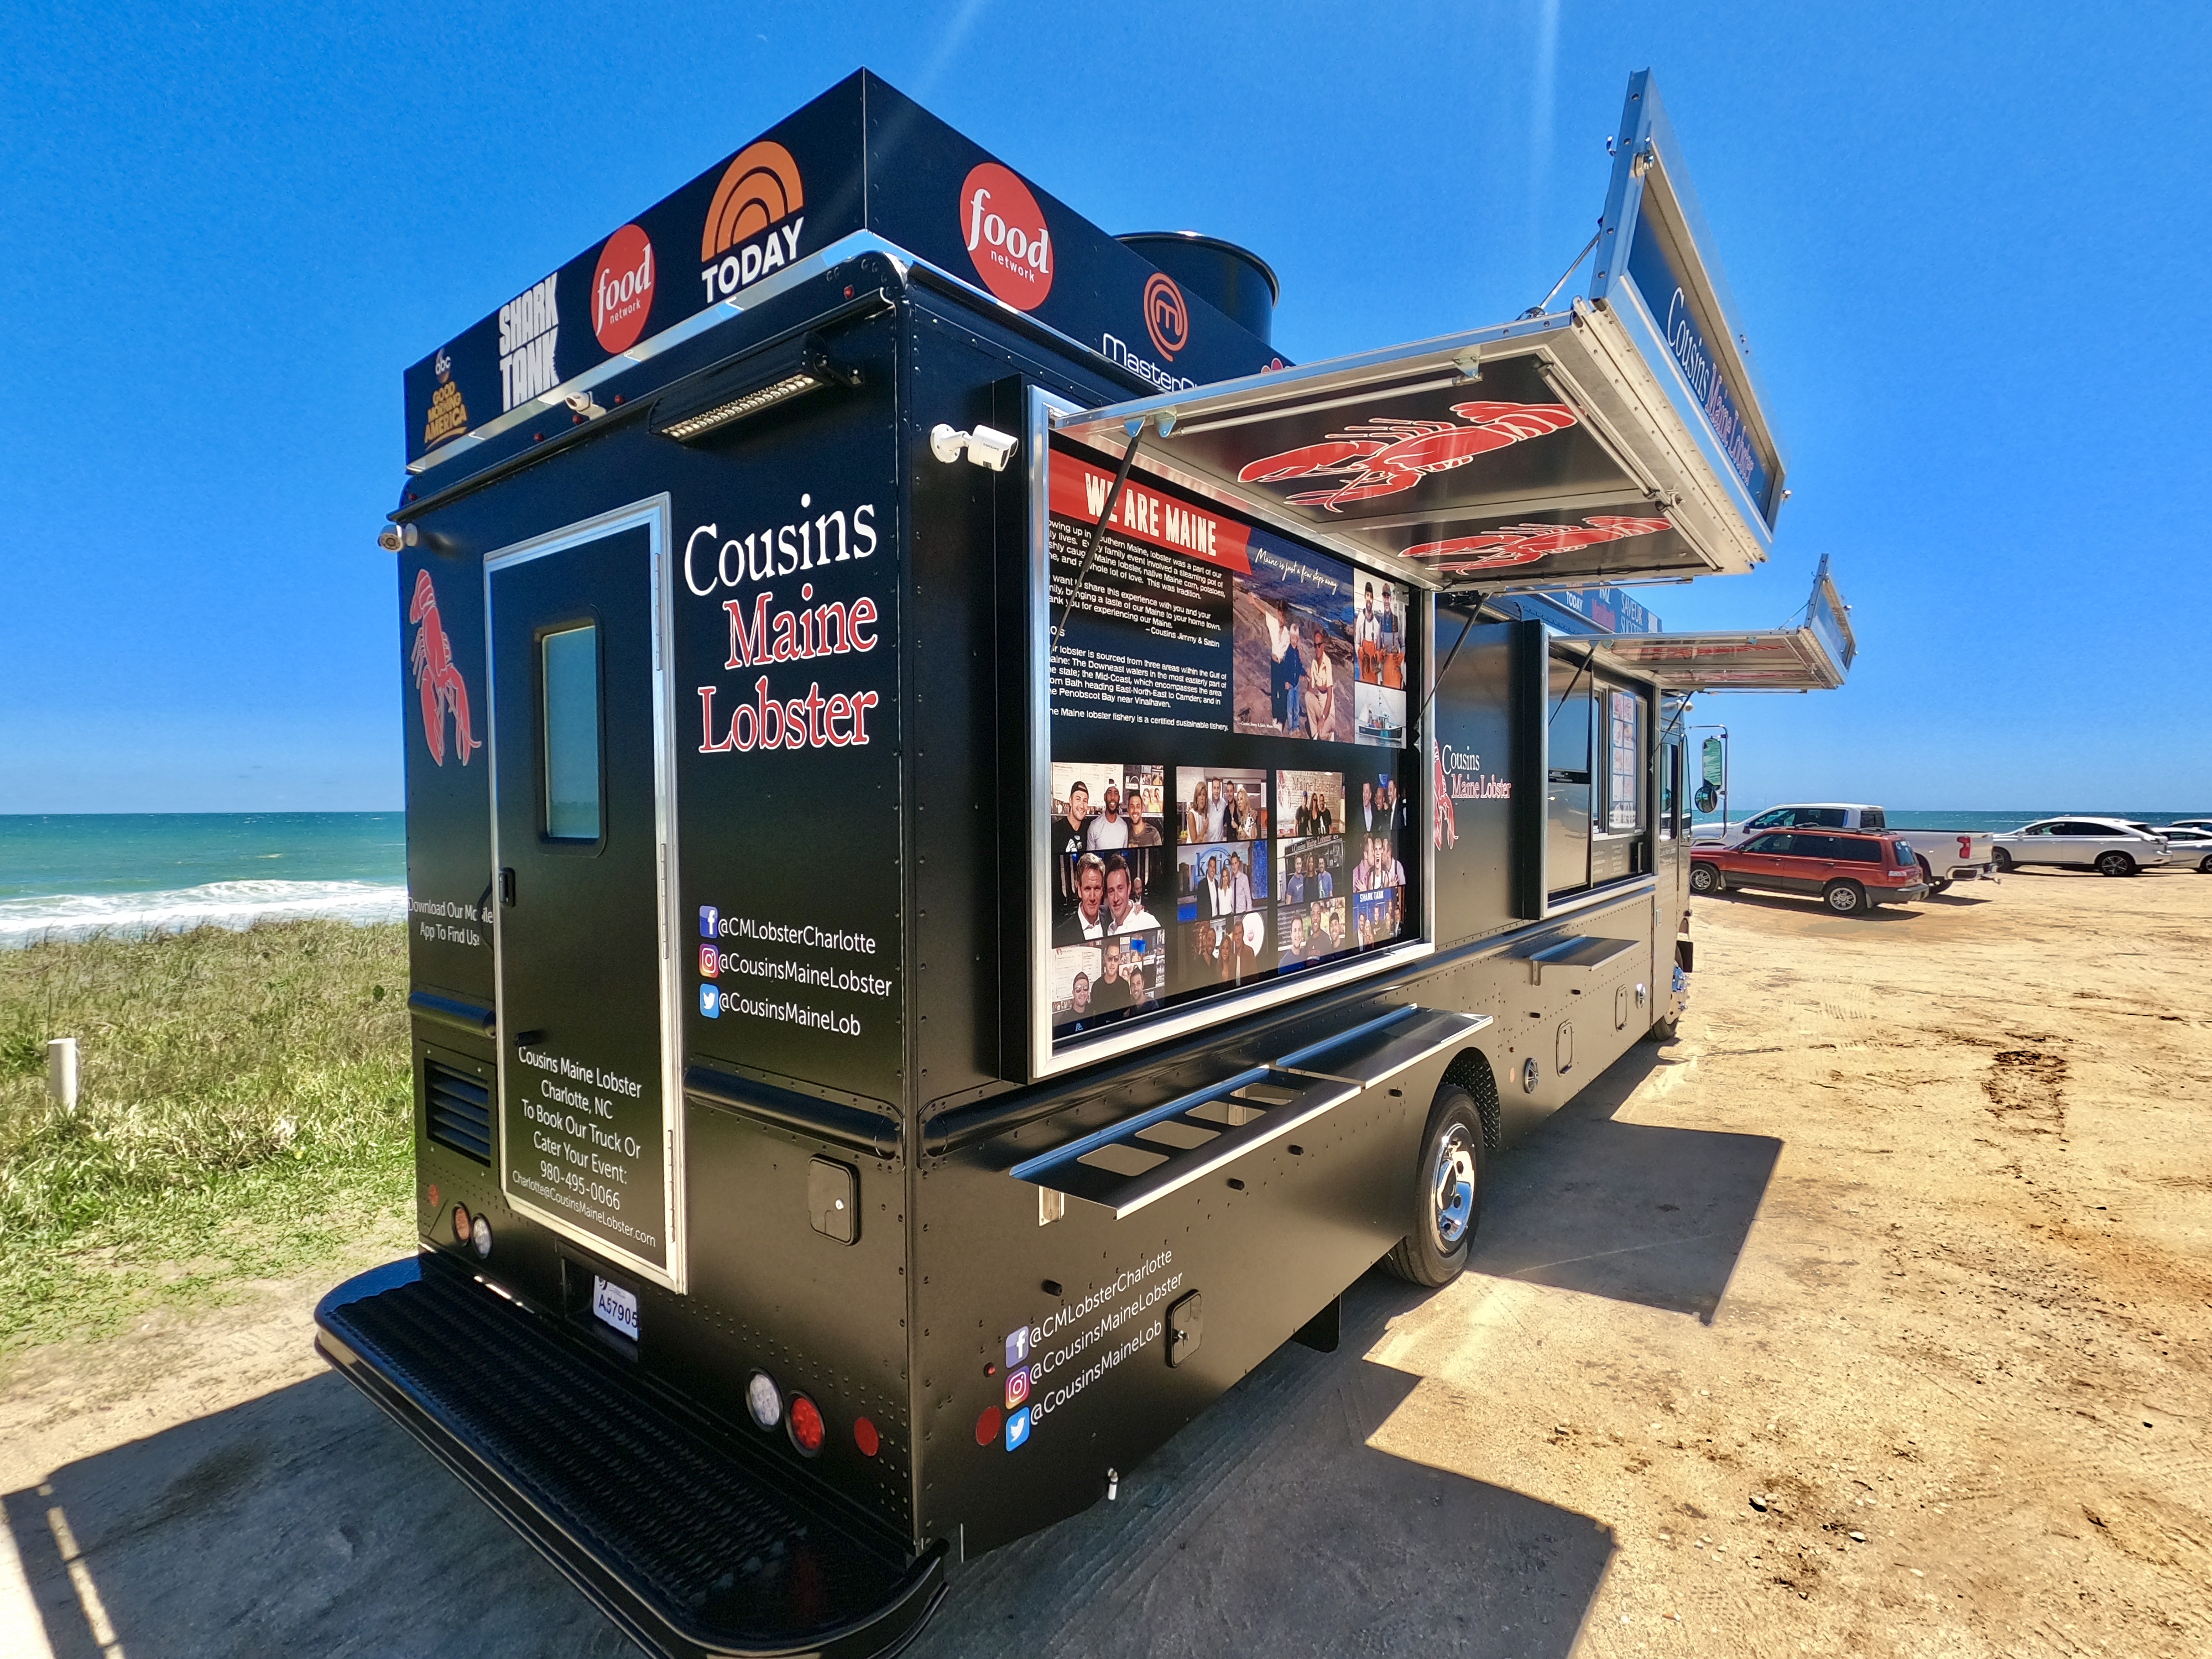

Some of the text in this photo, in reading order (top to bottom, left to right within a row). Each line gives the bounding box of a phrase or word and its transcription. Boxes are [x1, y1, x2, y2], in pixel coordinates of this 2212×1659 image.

[968, 188, 1050, 274] food
[701, 217, 805, 304] TODAY
[991, 249, 1036, 283] network
[595, 243, 653, 337] food
[499, 272, 559, 357] SHARK
[609, 298, 641, 325] network
[1667, 286, 1710, 403] Cousins
[435, 356, 451, 375] abc
[499, 325, 560, 412] TANK
[427, 391, 462, 422] MORNING
[432, 381, 456, 405] GOOD
[424, 403, 467, 443] AMERICA
[1124, 488, 1160, 537] ARE
[1166, 504, 1217, 556] MAINE
[684, 493, 878, 596] Cousins
[1059, 533, 1078, 545] lives.
[1104, 546, 1125, 560] family
[1127, 555, 1145, 565] event
[1147, 559, 1172, 573] involved
[1180, 570, 1206, 585] steaming
[1073, 527, 1083, 536] up
[1127, 543, 1149, 557] Maine,
[1151, 551, 1172, 563] lobster
[1173, 559, 1186, 568] was
[1193, 565, 1204, 574] part
[1061, 555, 1201, 599] and lot love. This was tradition.
[1094, 553, 1226, 598] Maine lobster, native Maine corn, potatoes,
[1255, 547, 1279, 565] Maine
[1279, 560, 1285, 570] is
[1282, 561, 1297, 581] just
[1301, 565, 1312, 583] few
[1312, 568, 1324, 588] steps
[1052, 575, 1073, 586] want
[1084, 582, 1105, 593] share
[1107, 587, 1119, 597] this
[1121, 591, 1157, 606] experience
[1159, 601, 1172, 610] with
[1198, 611, 1211, 619] your
[1082, 602, 1092, 610] for
[1094, 606, 1138, 622] experiencing
[1152, 617, 1173, 629] Maine.
[1105, 597, 1122, 607] taste
[1145, 606, 1165, 617] Maine
[1188, 617, 1205, 627] home
[1206, 620, 1221, 631] town.
[1566, 591, 1583, 612] TODAY
[1621, 593, 1643, 625] SAVEUR
[722, 583, 878, 670] Maine
[1151, 627, 1176, 639] Cousins
[1177, 632, 1197, 644] Jimmy
[1203, 638, 1220, 648] Sabin
[1058, 667, 1080, 678] state;
[1082, 670, 1093, 679] the
[1095, 671, 1132, 685] Mid-Coast,
[1134, 677, 1153, 687] which
[1155, 681, 1198, 693] encompasses
[1060, 645, 1086, 657] lobster
[1096, 653, 1125, 663] sourced
[1126, 656, 1142, 666] from
[1144, 659, 1160, 669] three
[1162, 664, 1180, 672] areas
[1181, 666, 1198, 676] within
[1209, 671, 1220, 679] Gulf
[1072, 658, 1086, 667] The
[1088, 660, 1124, 673] Downeast
[1126, 667, 1149, 676] waters
[1157, 671, 1167, 680] the
[1168, 674, 1184, 682] most
[1185, 676, 1207, 686] easterly
[1059, 688, 1100, 700] Penobscot
[1102, 693, 1115, 703] Bay
[1134, 697, 1171, 708] Vinalhaven.
[1065, 678, 1083, 687] Bath
[1084, 681, 1114, 692] heading
[1116, 684, 1167, 698] East-North-East
[1176, 692, 1202, 703] Camden;
[1203, 696, 1214, 705] and
[697, 675, 879, 753] Lobster
[1061, 708, 1085, 717] Maine
[1086, 710, 1111, 720] lobster
[1113, 713, 1135, 723] fishery
[1150, 717, 1175, 726] certified
[1176, 720, 1209, 729] sustainable
[1209, 722, 1229, 732] fishery.
[1442, 744, 1480, 775] Cousins
[1292, 776, 1313, 791] Maine
[1451, 773, 1512, 799] Maine Lobster
[408, 896, 446, 916] Download
[447, 901, 463, 919] Our
[420, 921, 480, 946] App To Find Us!
[718, 917, 876, 954] @CMLobsterCharlotte
[718, 953, 892, 997] @CousinsMaineLobster
[719, 992, 860, 1036] @CousinsMaineLob
[519, 1046, 642, 1098] Cousins Maine Lobster
[541, 1079, 613, 1119] Charlotte, NC
[521, 1098, 641, 1159] To Book Our Truck Or
[533, 1131, 628, 1185] Cater Your Event:
[540, 1160, 620, 1211] 980-495-0066
[513, 1170, 656, 1248] Charlotte@CousinsMaineLobster.com
[598, 1294, 638, 1328] A57905
[1029, 1250, 1172, 1348] @CMLobsterCharlotte
[1030, 1272, 1183, 1385] @CousinsMaineLobster
[1030, 1320, 1162, 1426] @CousinsMaineLob
